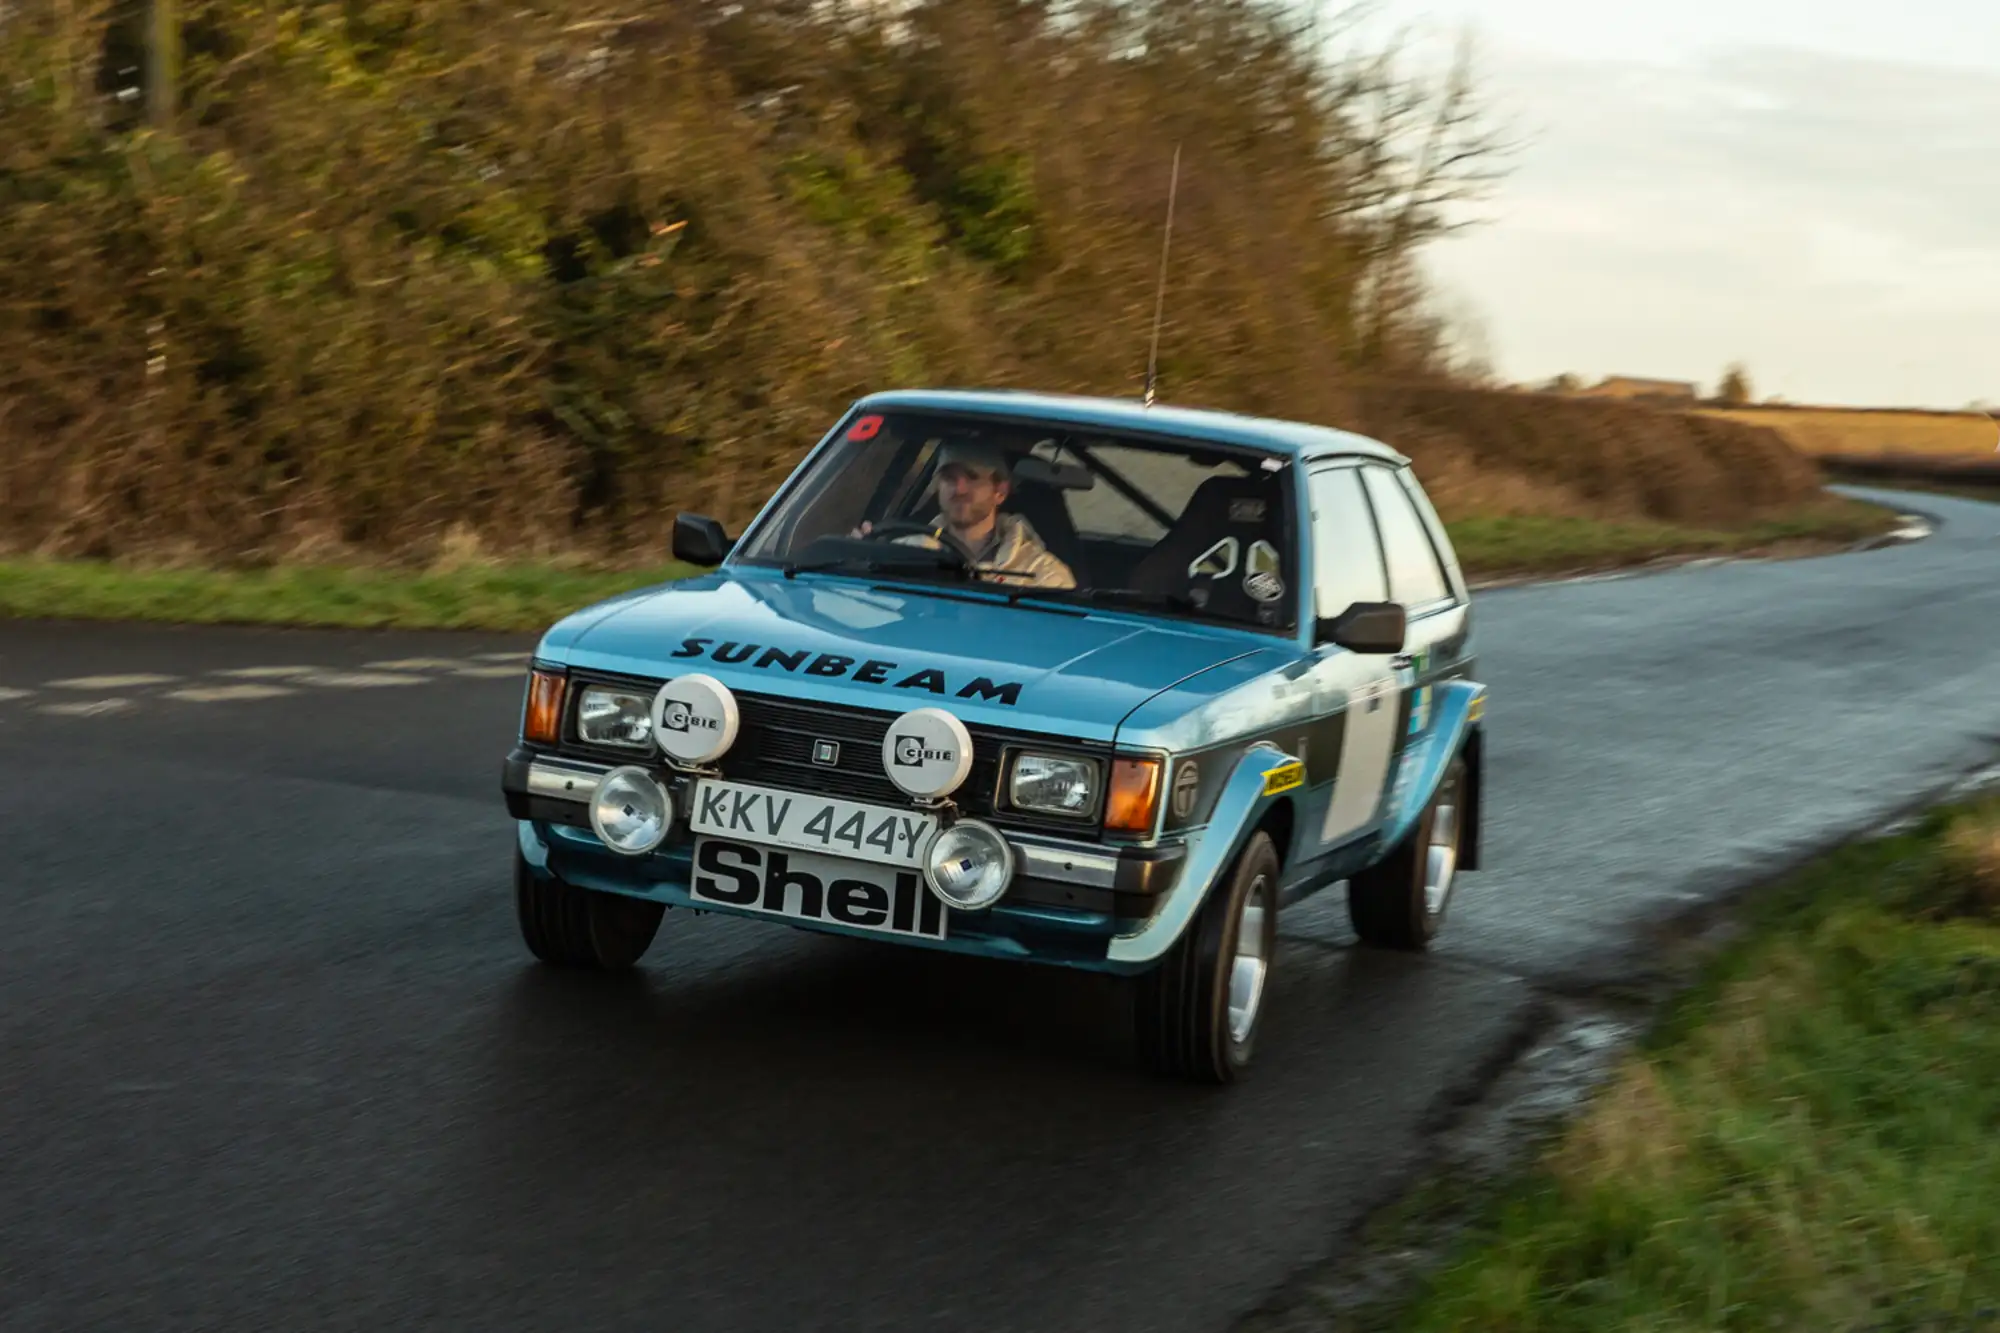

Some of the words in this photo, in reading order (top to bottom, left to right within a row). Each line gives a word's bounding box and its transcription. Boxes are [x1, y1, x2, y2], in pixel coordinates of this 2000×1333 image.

[670, 638, 1023, 706] SUNBEAM
[699, 786, 792, 836] KKV
[803, 805, 929, 858] 444Y
[696, 840, 942, 936] Shell
